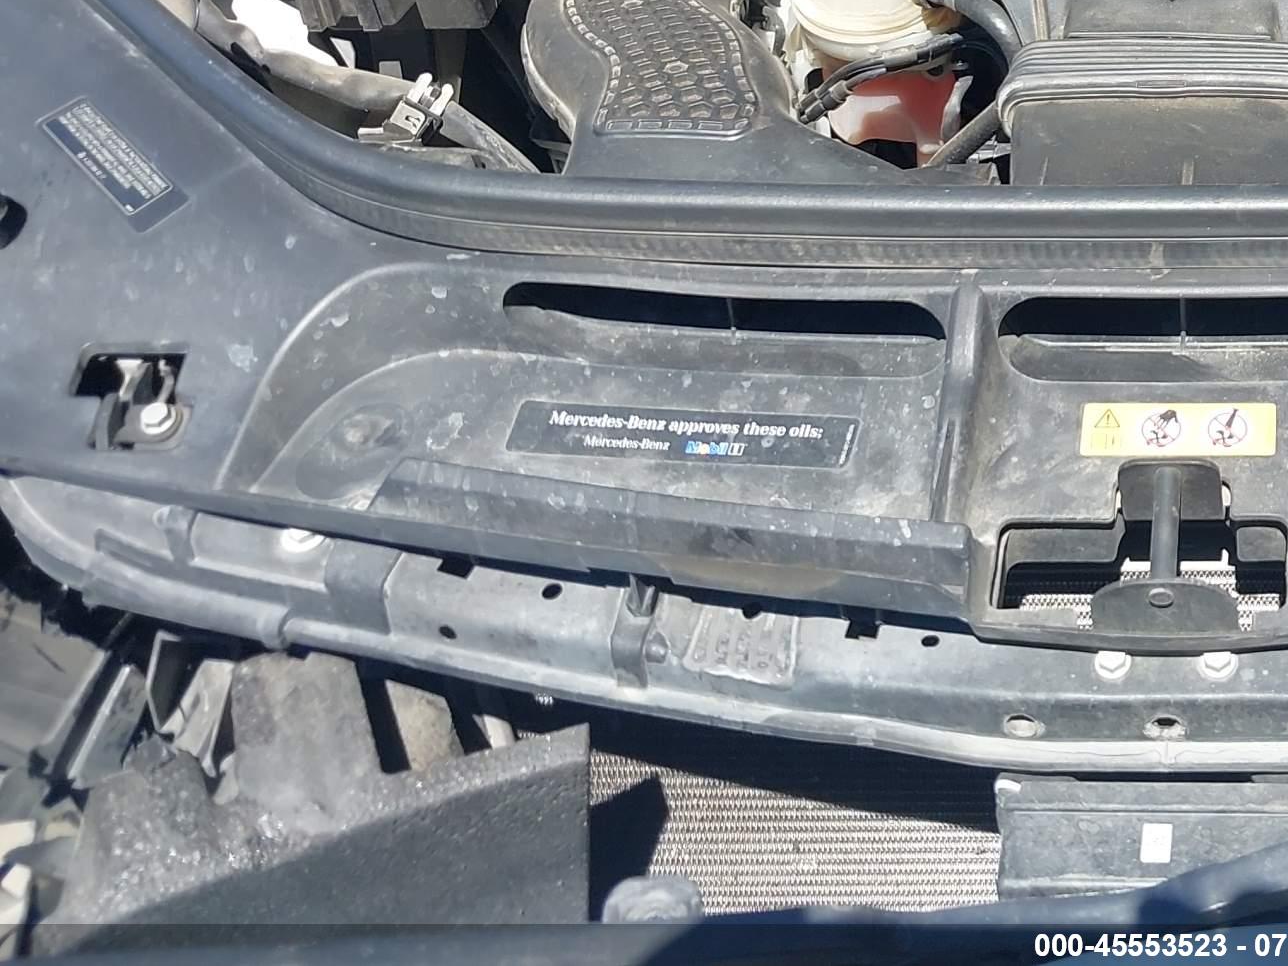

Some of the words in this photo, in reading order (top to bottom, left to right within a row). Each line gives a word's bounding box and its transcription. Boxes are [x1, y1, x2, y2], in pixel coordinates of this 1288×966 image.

[549, 410, 666, 431] Mercedes-Benz
[668, 420, 740, 436] approves
[743, 421, 787, 437] these
[583, 434, 671, 451] Mercedes-Benz
[685, 440, 727, 456] Mobil
